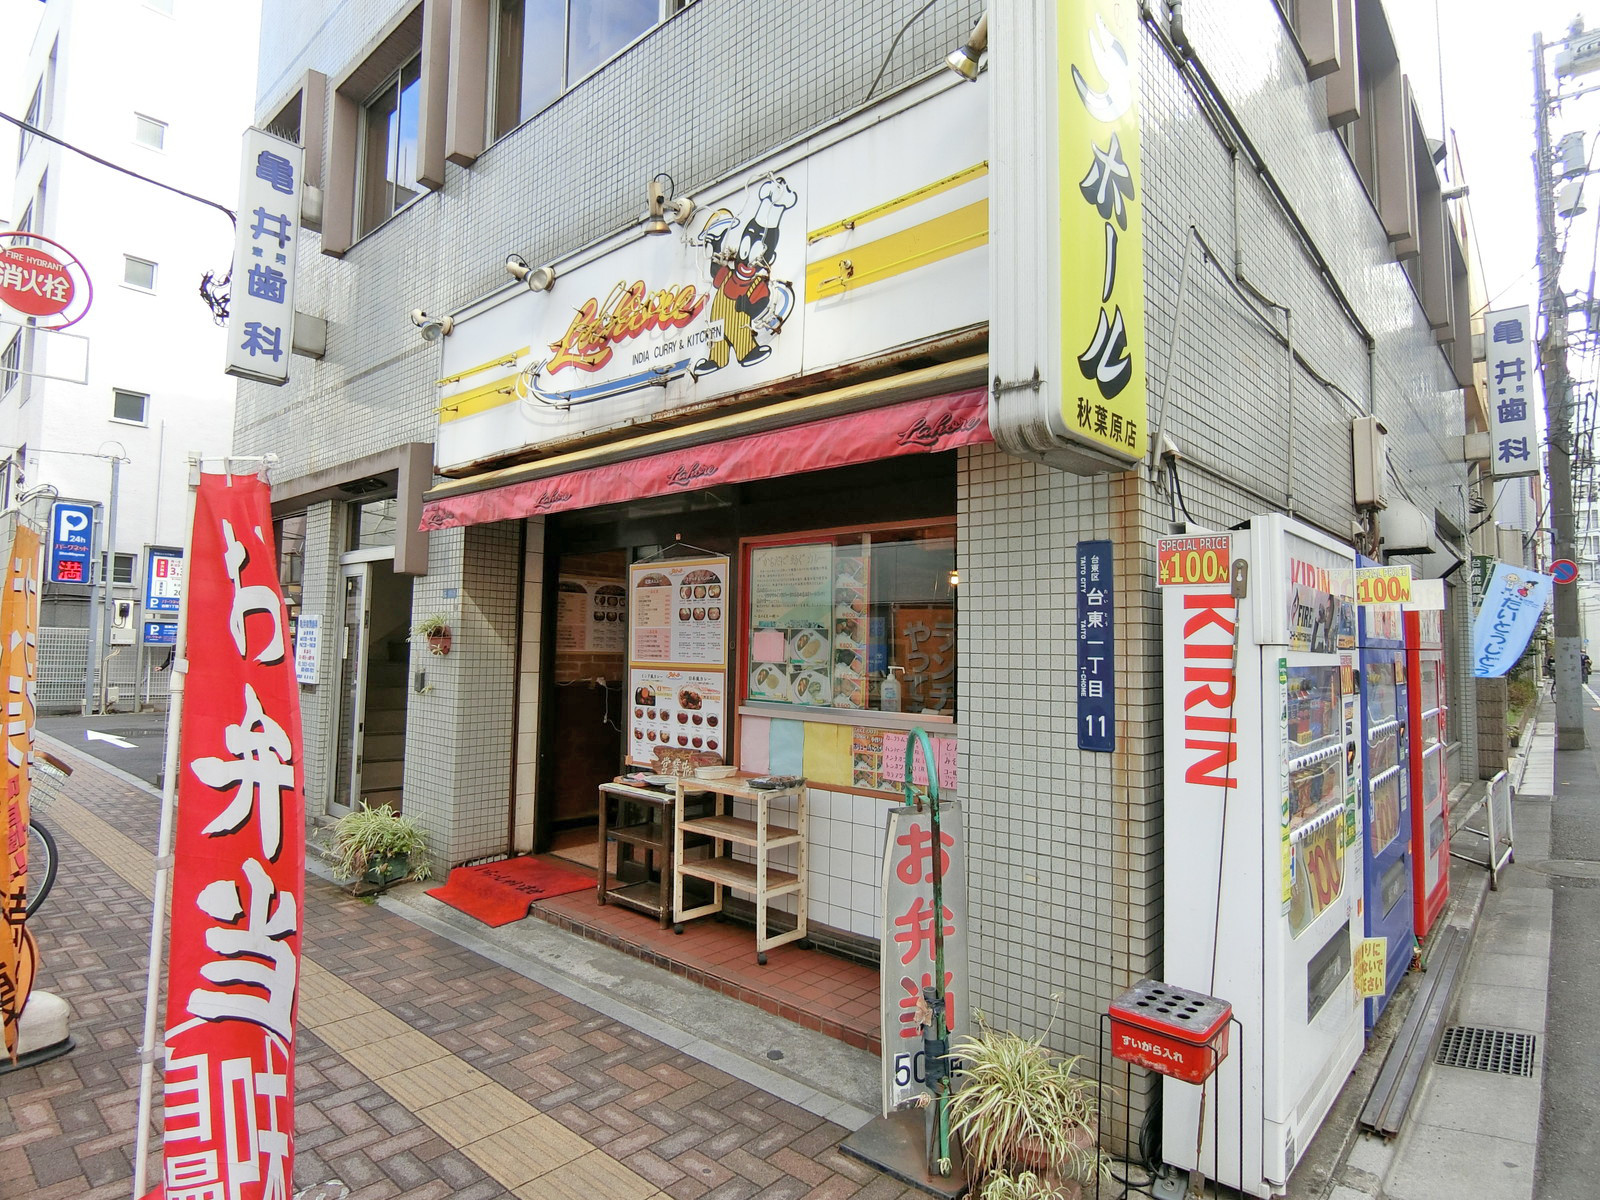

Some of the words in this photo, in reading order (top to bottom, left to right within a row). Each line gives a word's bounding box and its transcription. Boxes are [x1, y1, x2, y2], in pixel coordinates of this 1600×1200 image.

[5, 250, 24, 262] FIRE
[26, 255, 64, 272] HYDRANT
[0, 261, 70, 303] 消火栓
[546, 280, 710, 376] Lahore
[632, 351, 650, 366] INDIA
[653, 340, 677, 359] CURRY
[678, 339, 685, 351] &
[896, 413, 981, 447] Lahore
[1077, 397, 1137, 449] 秋葉原店
[668, 462, 719, 487] Lahore
[534, 490, 573, 509] Lahore
[60, 510, 88, 541] P
[69, 535, 86, 543] 24h
[1161, 539, 1198, 552] SPECIAL
[1200, 536, 1228, 550] PRICE
[58, 561, 82, 581] 満
[1090, 555, 1100, 582] 台東区
[1297, 605, 1313, 628] FIRE
[1086, 587, 1104, 698] 台東一丁目
[1183, 593, 1238, 789] KIRIN
[1086, 715, 1106, 738] 11
[893, 822, 955, 1040] お弁当
[1121, 1035, 1184, 1064] すいがら入れ
